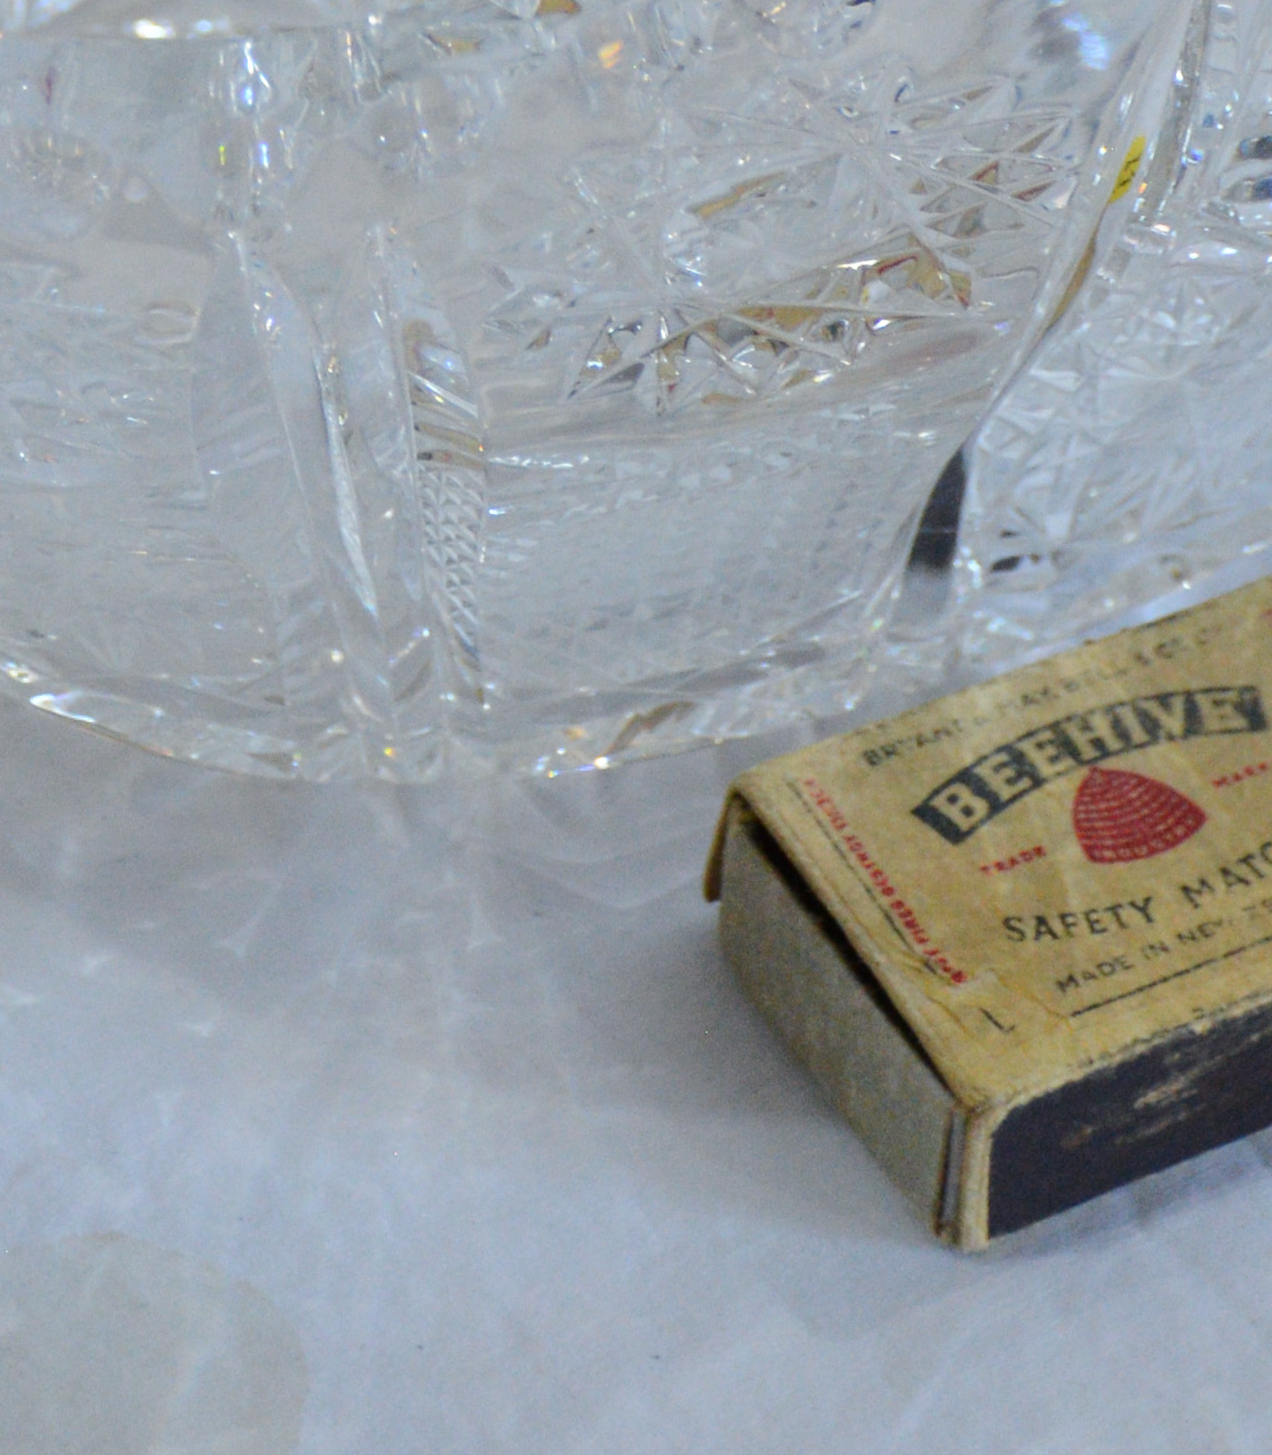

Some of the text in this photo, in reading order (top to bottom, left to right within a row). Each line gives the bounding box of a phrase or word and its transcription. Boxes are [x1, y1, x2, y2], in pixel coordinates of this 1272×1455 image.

[930, 689, 1259, 837] BEEHIVE
[979, 761, 1270, 877] TRADE MARK
[1002, 895, 1156, 942] SAFETY
[1055, 955, 1134, 994] MADE
[1143, 943, 1171, 960] IN
